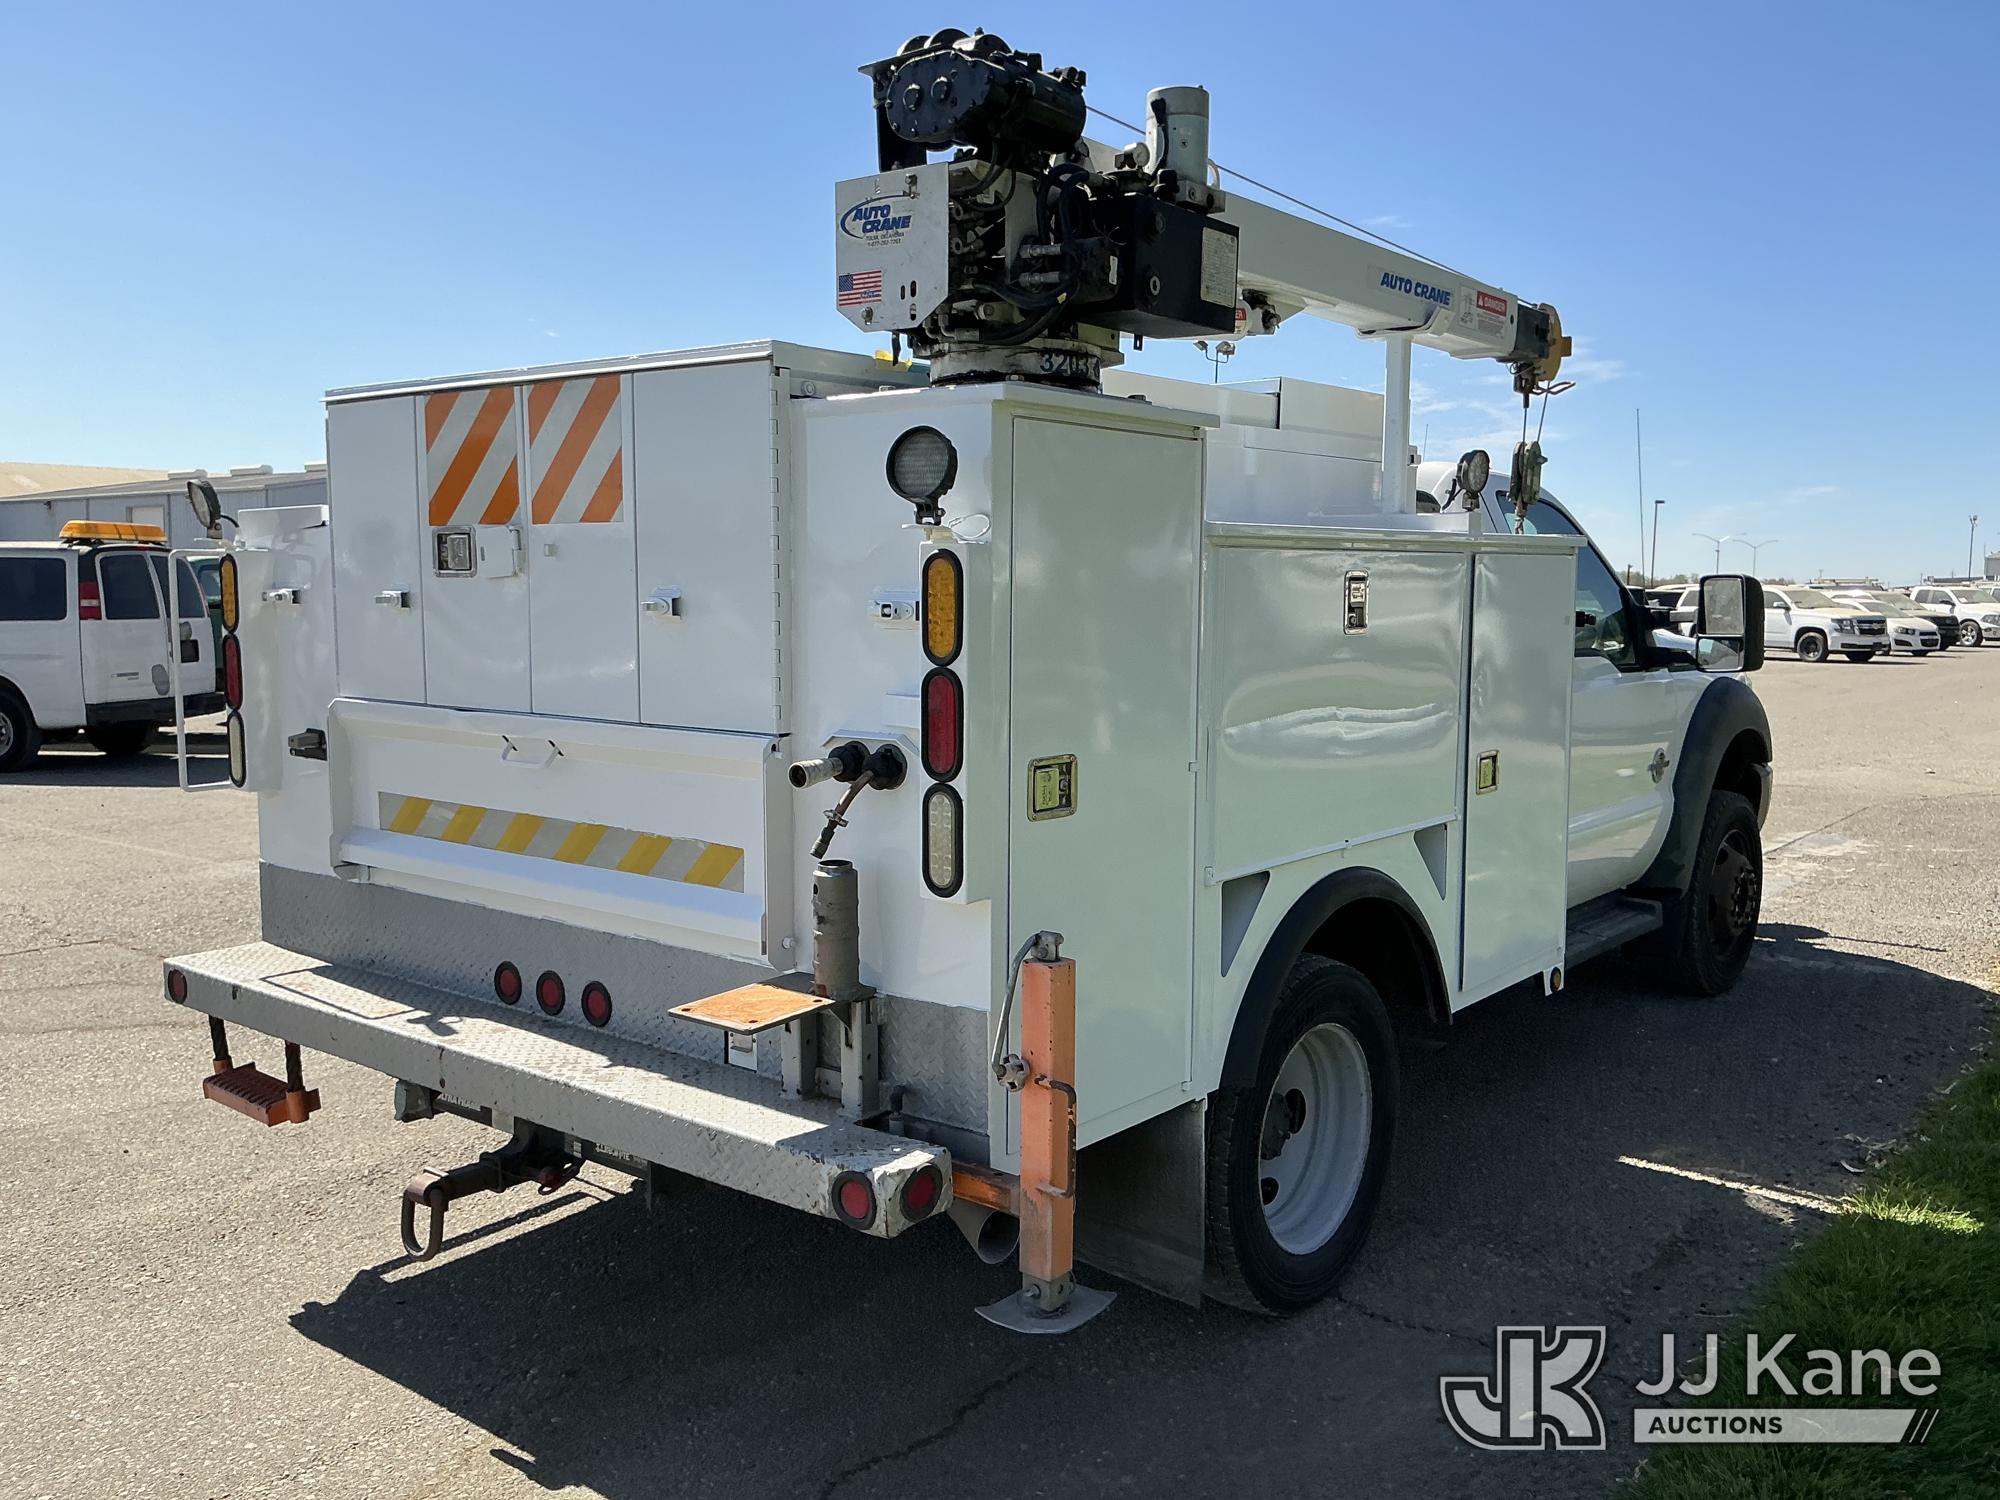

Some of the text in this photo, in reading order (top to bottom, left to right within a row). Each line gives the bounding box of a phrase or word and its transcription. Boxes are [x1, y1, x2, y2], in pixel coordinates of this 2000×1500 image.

[852, 204, 891, 221] AUTO
[862, 215, 912, 233] CRANE
[1381, 272, 1451, 306] AUTO CRANE
